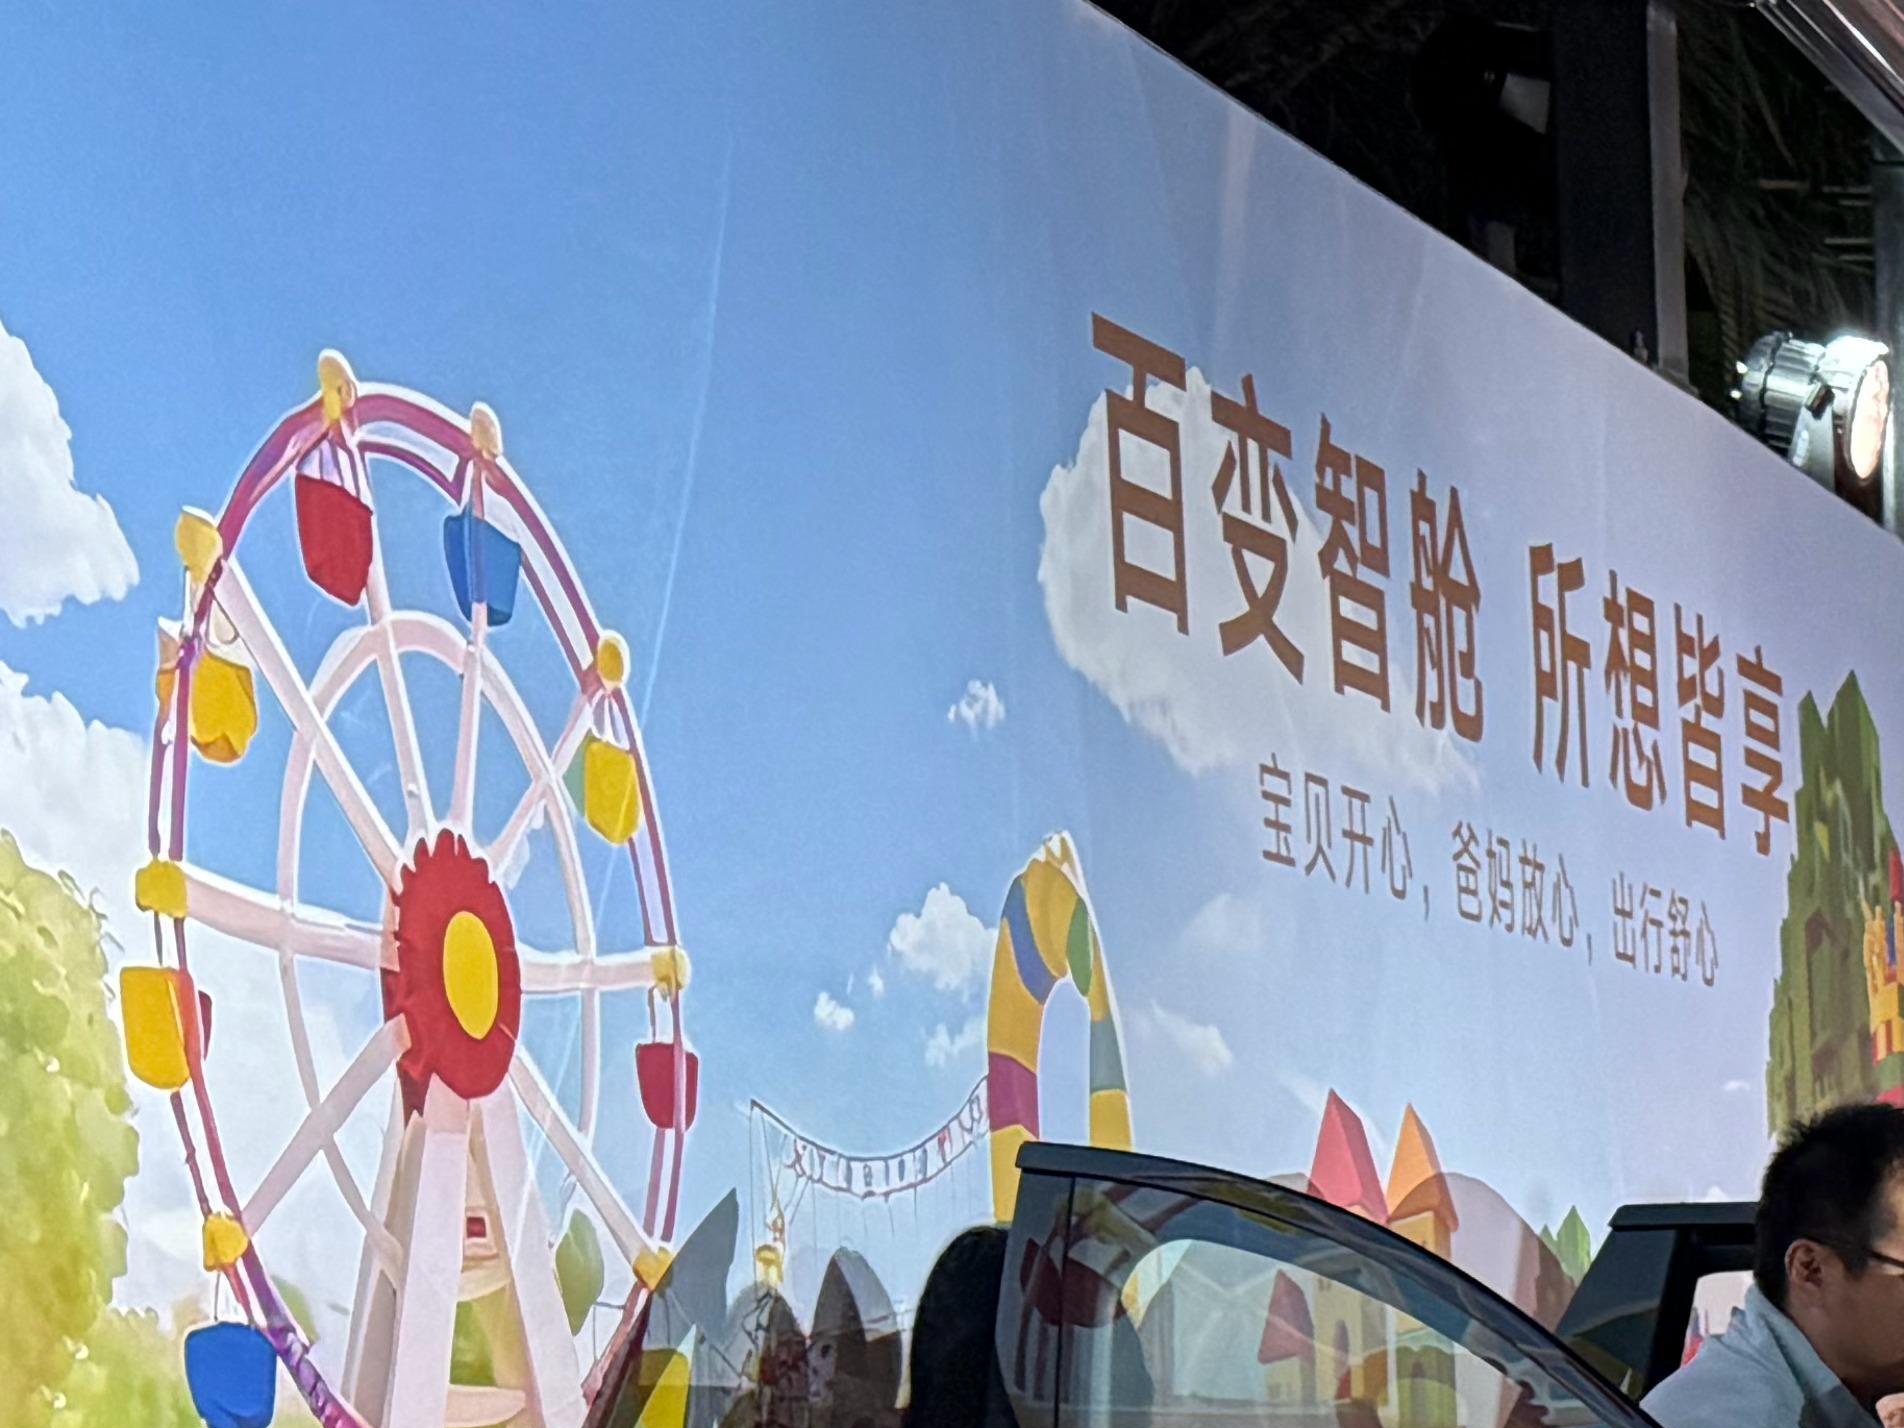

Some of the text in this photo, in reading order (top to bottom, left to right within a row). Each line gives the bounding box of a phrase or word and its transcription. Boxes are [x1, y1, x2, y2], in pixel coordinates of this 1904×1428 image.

[1091, 311, 1790, 856] 百变智舱 所想皆享
